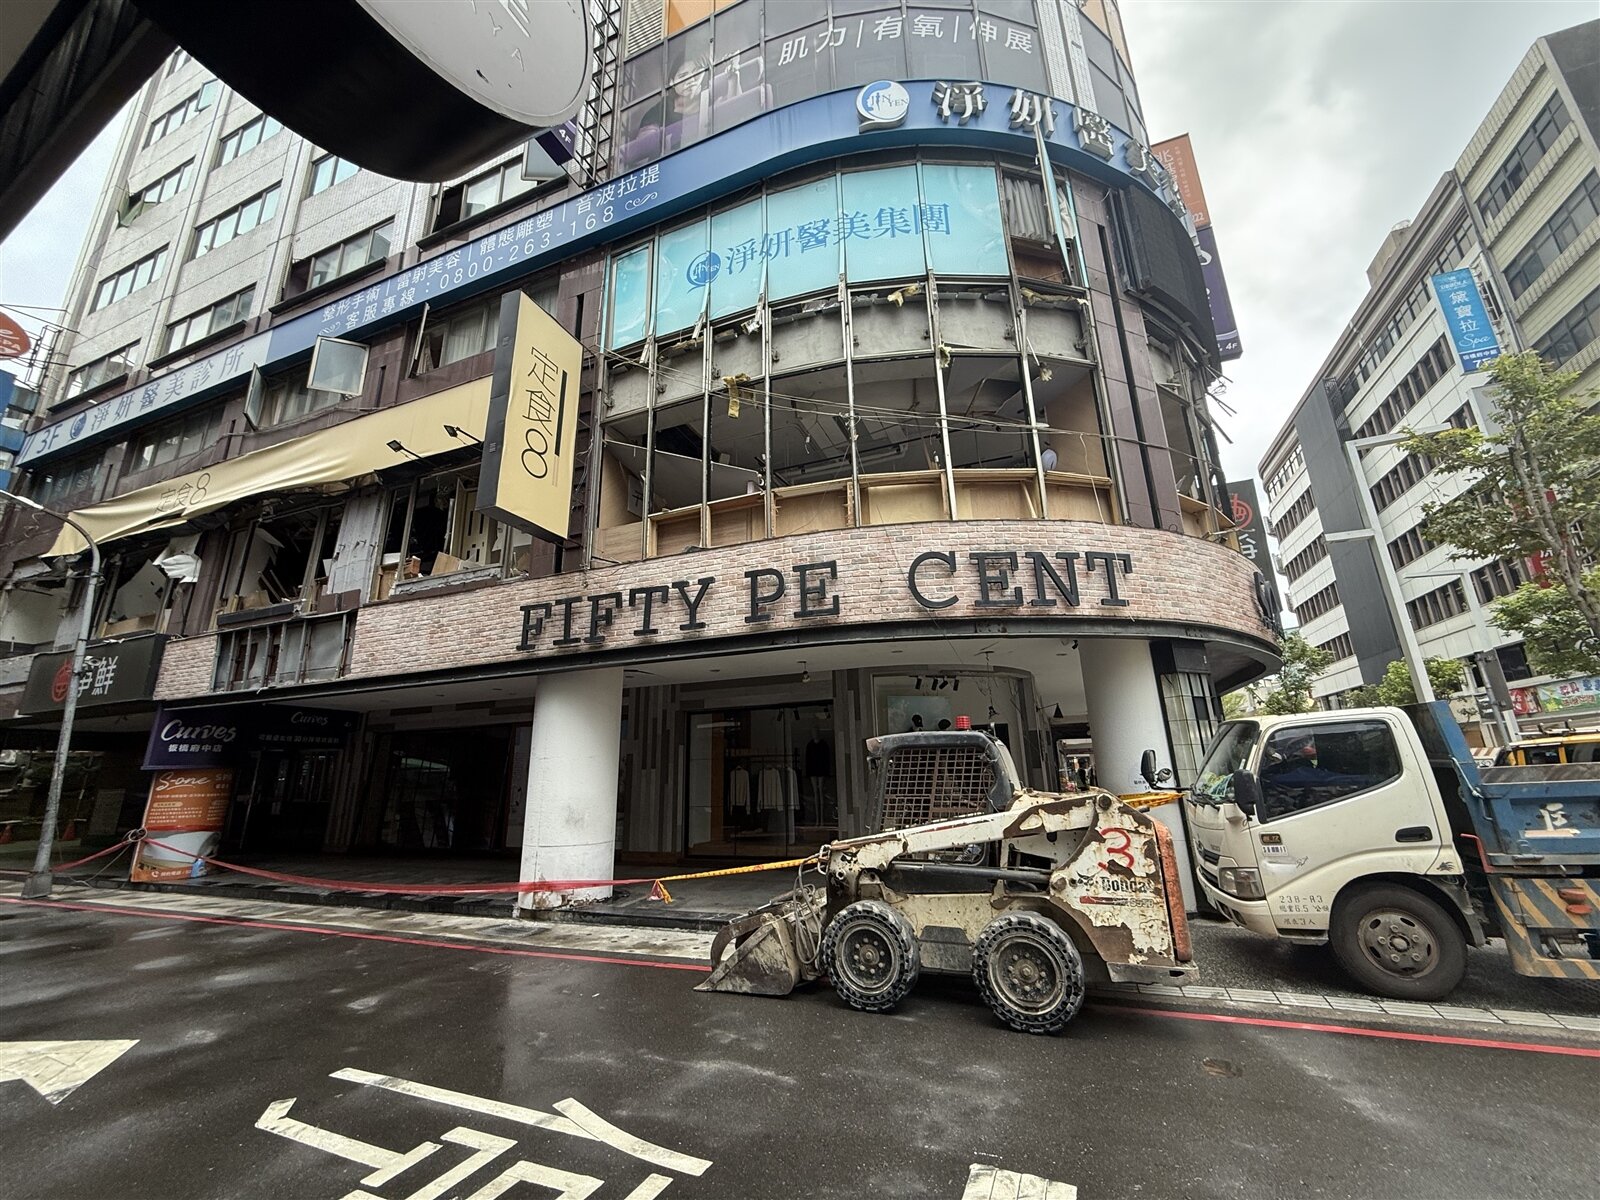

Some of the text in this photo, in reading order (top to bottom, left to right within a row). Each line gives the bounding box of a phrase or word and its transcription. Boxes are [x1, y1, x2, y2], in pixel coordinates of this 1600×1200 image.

[778, 14, 1033, 67] 肌力 有氧 伸展
[558, 128, 571, 144] 4F
[396, 249, 463, 291] 雷射美容
[479, 208, 553, 255] 體態雕塑
[575, 164, 661, 216] 音波拉提
[439, 203, 615, 290] 0800-263-168
[725, 202, 951, 276] 淨妍醫美集團
[1225, 341, 1238, 351] 4F
[1459, 333, 1491, 349] Spa
[36, 344, 245, 454] 3F 淨妍醫美診所
[520, 346, 559, 480] 定食8
[515, 575, 717, 651] FIFTY
[908, 550, 1133, 610] CENT
[160, 719, 238, 742] Curves
[290, 711, 329, 726] Curves
[1098, 827, 1135, 872] 3
